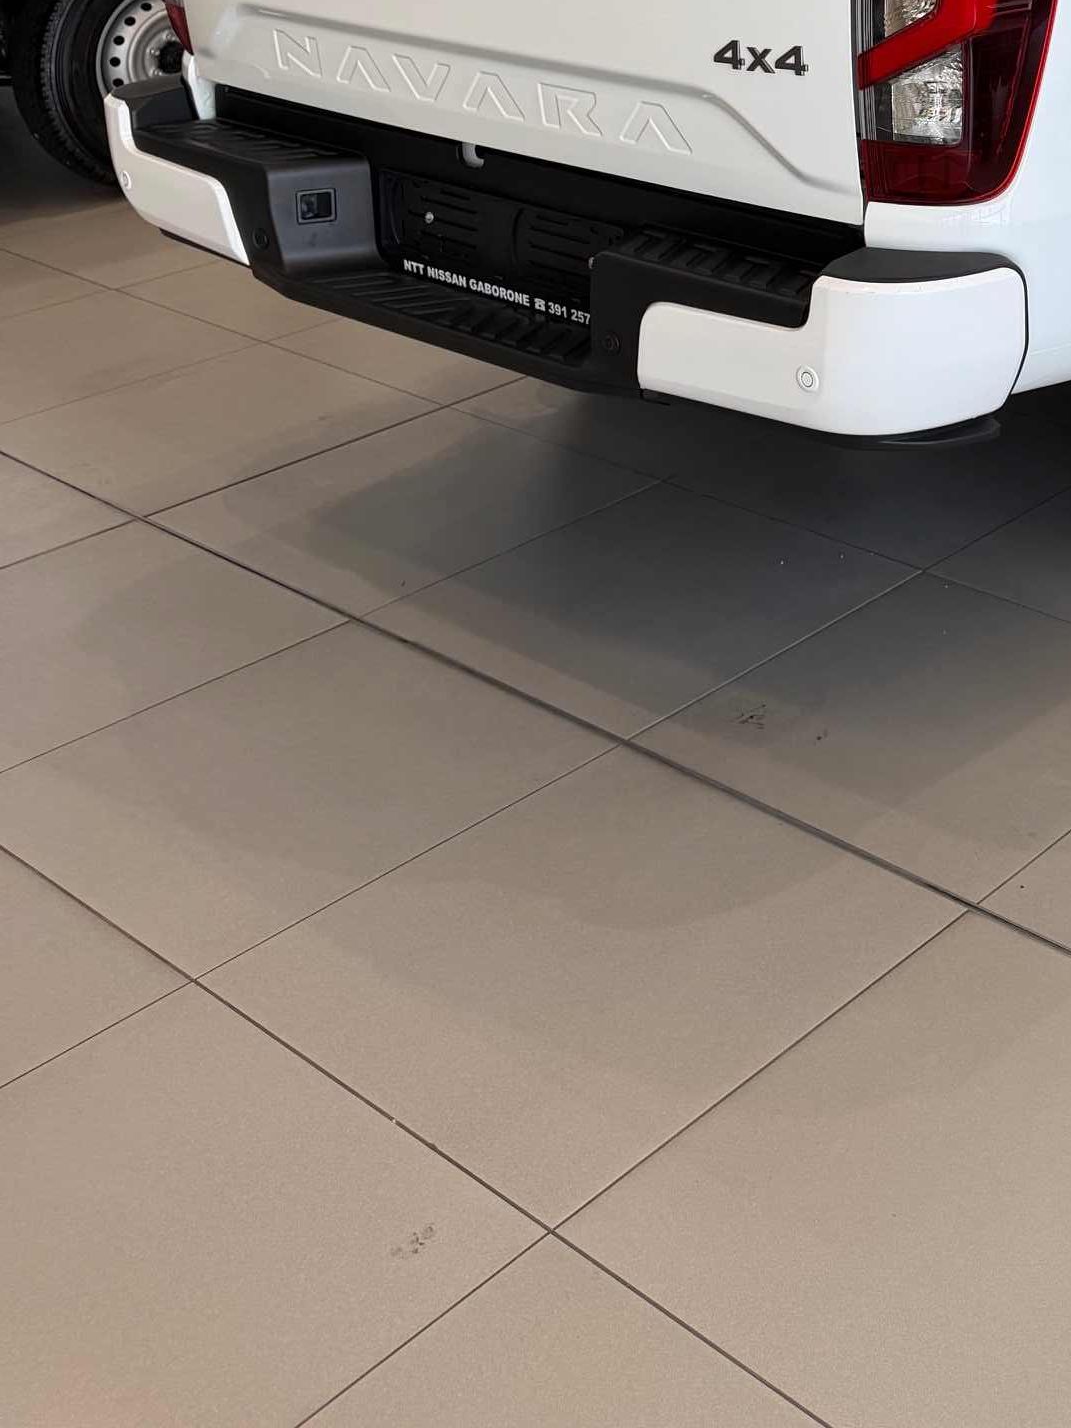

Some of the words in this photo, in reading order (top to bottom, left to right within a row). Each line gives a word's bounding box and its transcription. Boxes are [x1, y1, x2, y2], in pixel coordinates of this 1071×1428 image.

[713, 39, 809, 77] 4x4
[272, 27, 693, 156] NAVARA
[403, 258, 425, 275] NTT
[426, 265, 468, 289] NISSAN
[468, 277, 531, 307] GABORONE
[547, 301, 568, 319] 391
